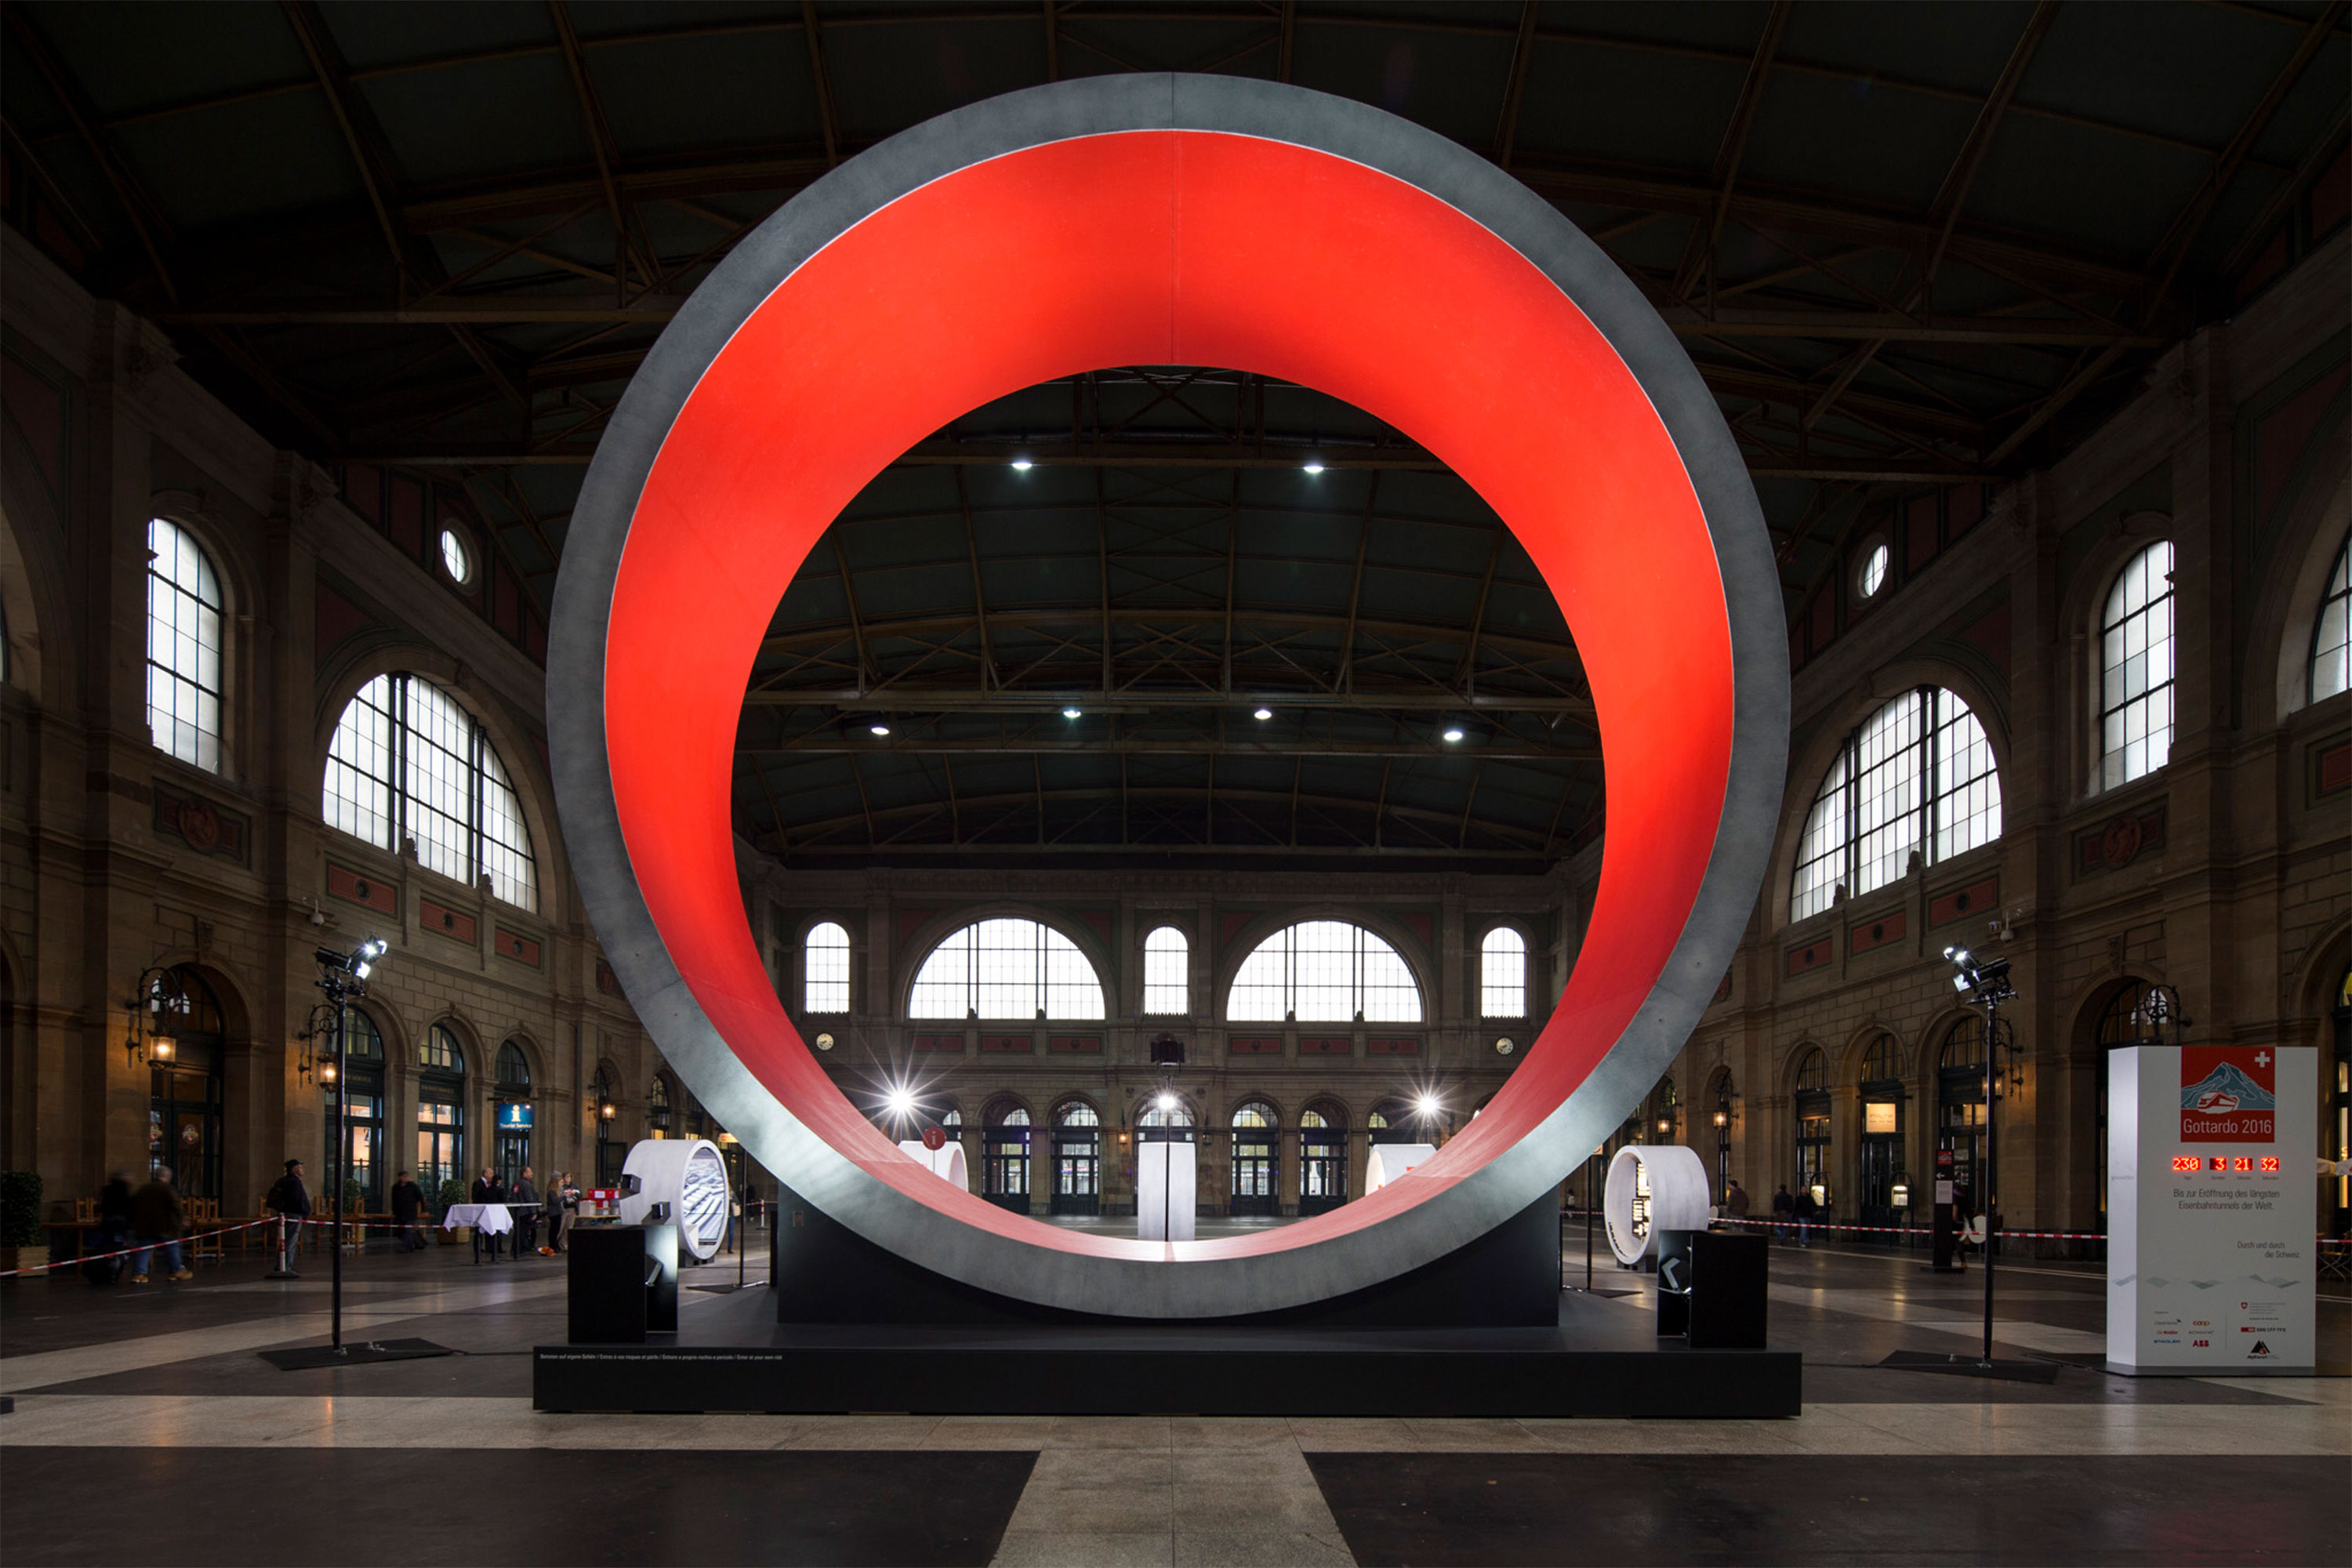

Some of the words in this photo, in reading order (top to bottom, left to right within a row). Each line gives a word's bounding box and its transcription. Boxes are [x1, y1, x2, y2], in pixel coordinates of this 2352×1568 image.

[2183, 1118, 2238, 1134] Gottardo
[2242, 1119, 2272, 1134] 2016
[2172, 1157, 2199, 1171] 230
[2215, 1157, 2225, 1171] 3
[2234, 1157, 2249, 1171] 21
[2260, 1157, 2278, 1171] 32
[2173, 1189, 2184, 1198] Bis
[2198, 1189, 2233, 1199] Eröffnung
[2234, 1189, 2248, 1198] des
[2249, 1189, 2280, 1200] längsten
[2178, 1201, 2240, 1210] Eisenbahntunnels
[2241, 1201, 2253, 1210] der
[2255, 1201, 2274, 1210] Welt.
